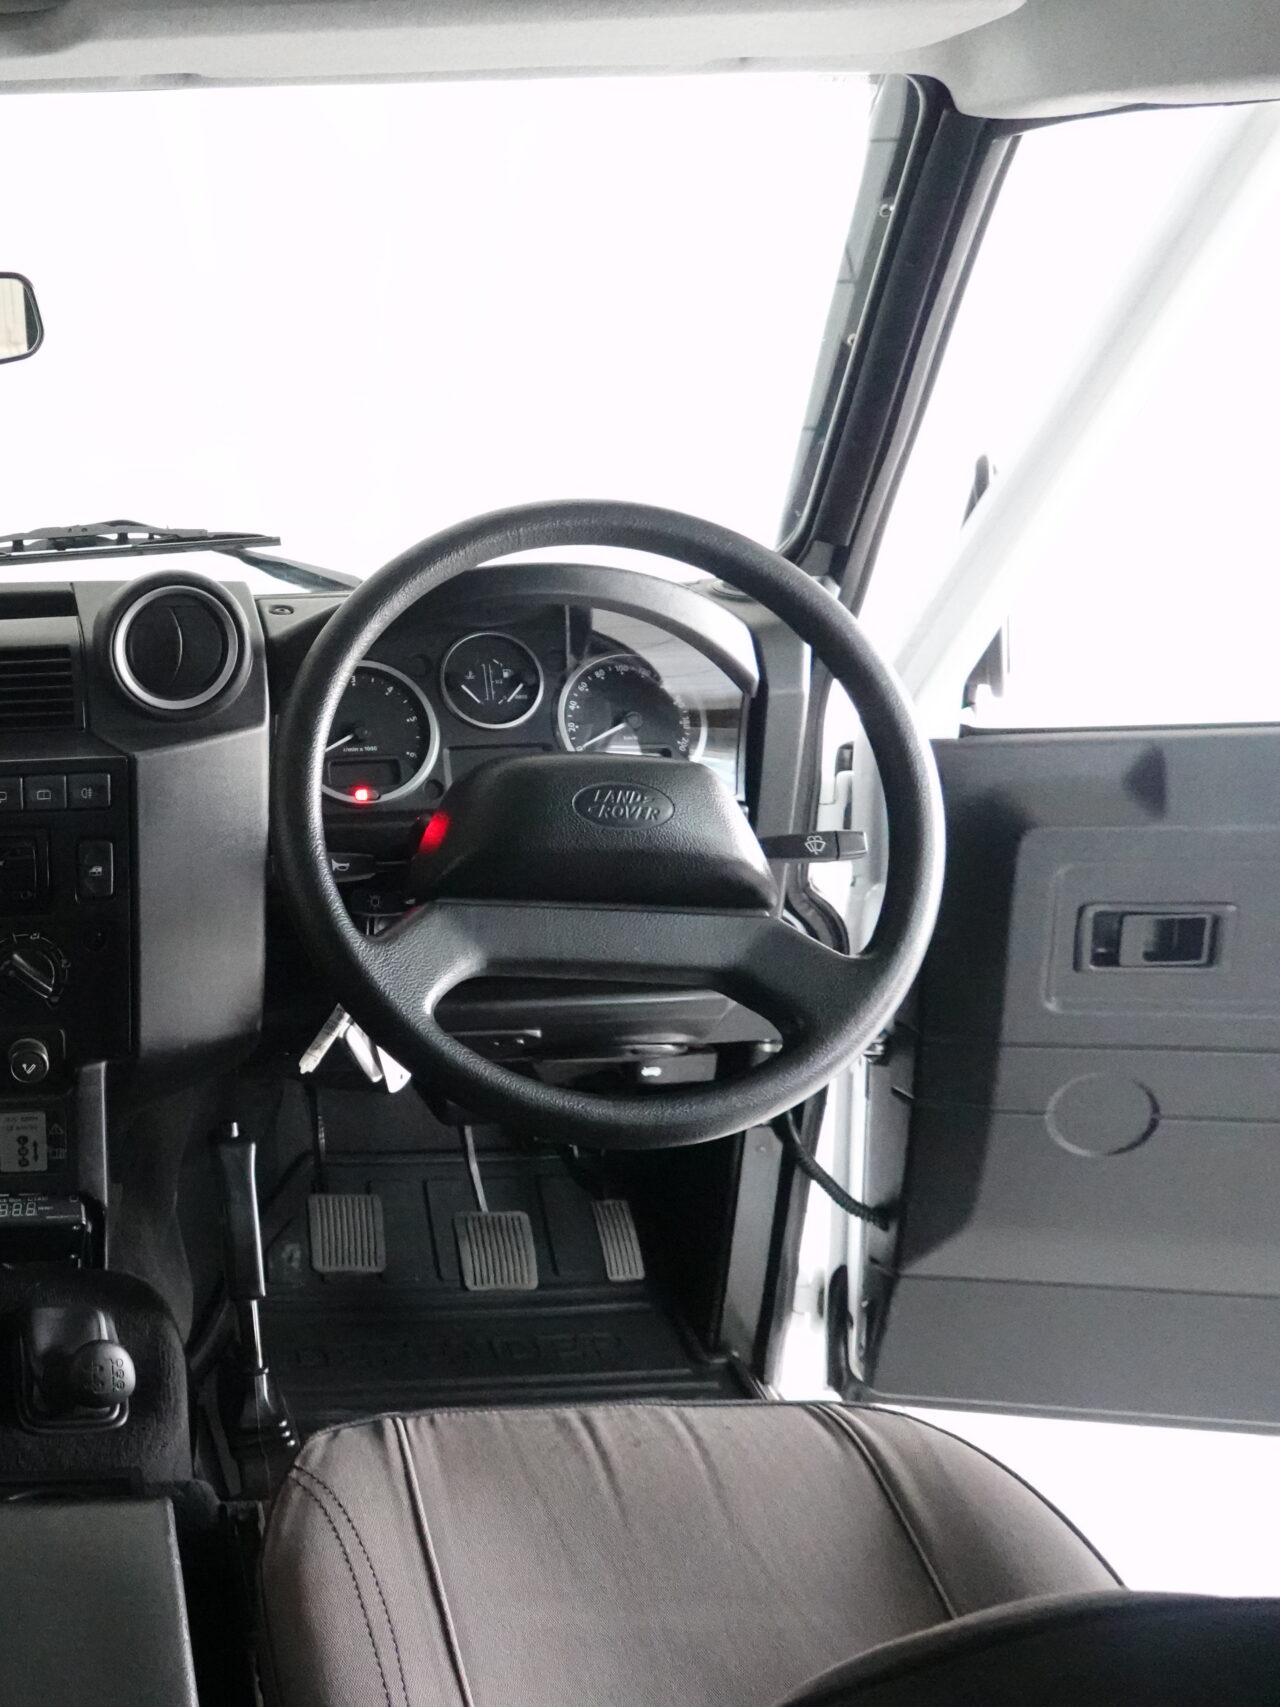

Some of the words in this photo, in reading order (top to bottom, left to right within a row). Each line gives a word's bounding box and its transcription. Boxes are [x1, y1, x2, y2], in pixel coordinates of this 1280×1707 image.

[594, 669, 606, 678] 80
[577, 681, 588, 692] 60
[568, 700, 577, 711] 40
[567, 722, 577, 733] 20
[593, 789, 642, 805] LAND
[598, 804, 660, 822] ROVER
